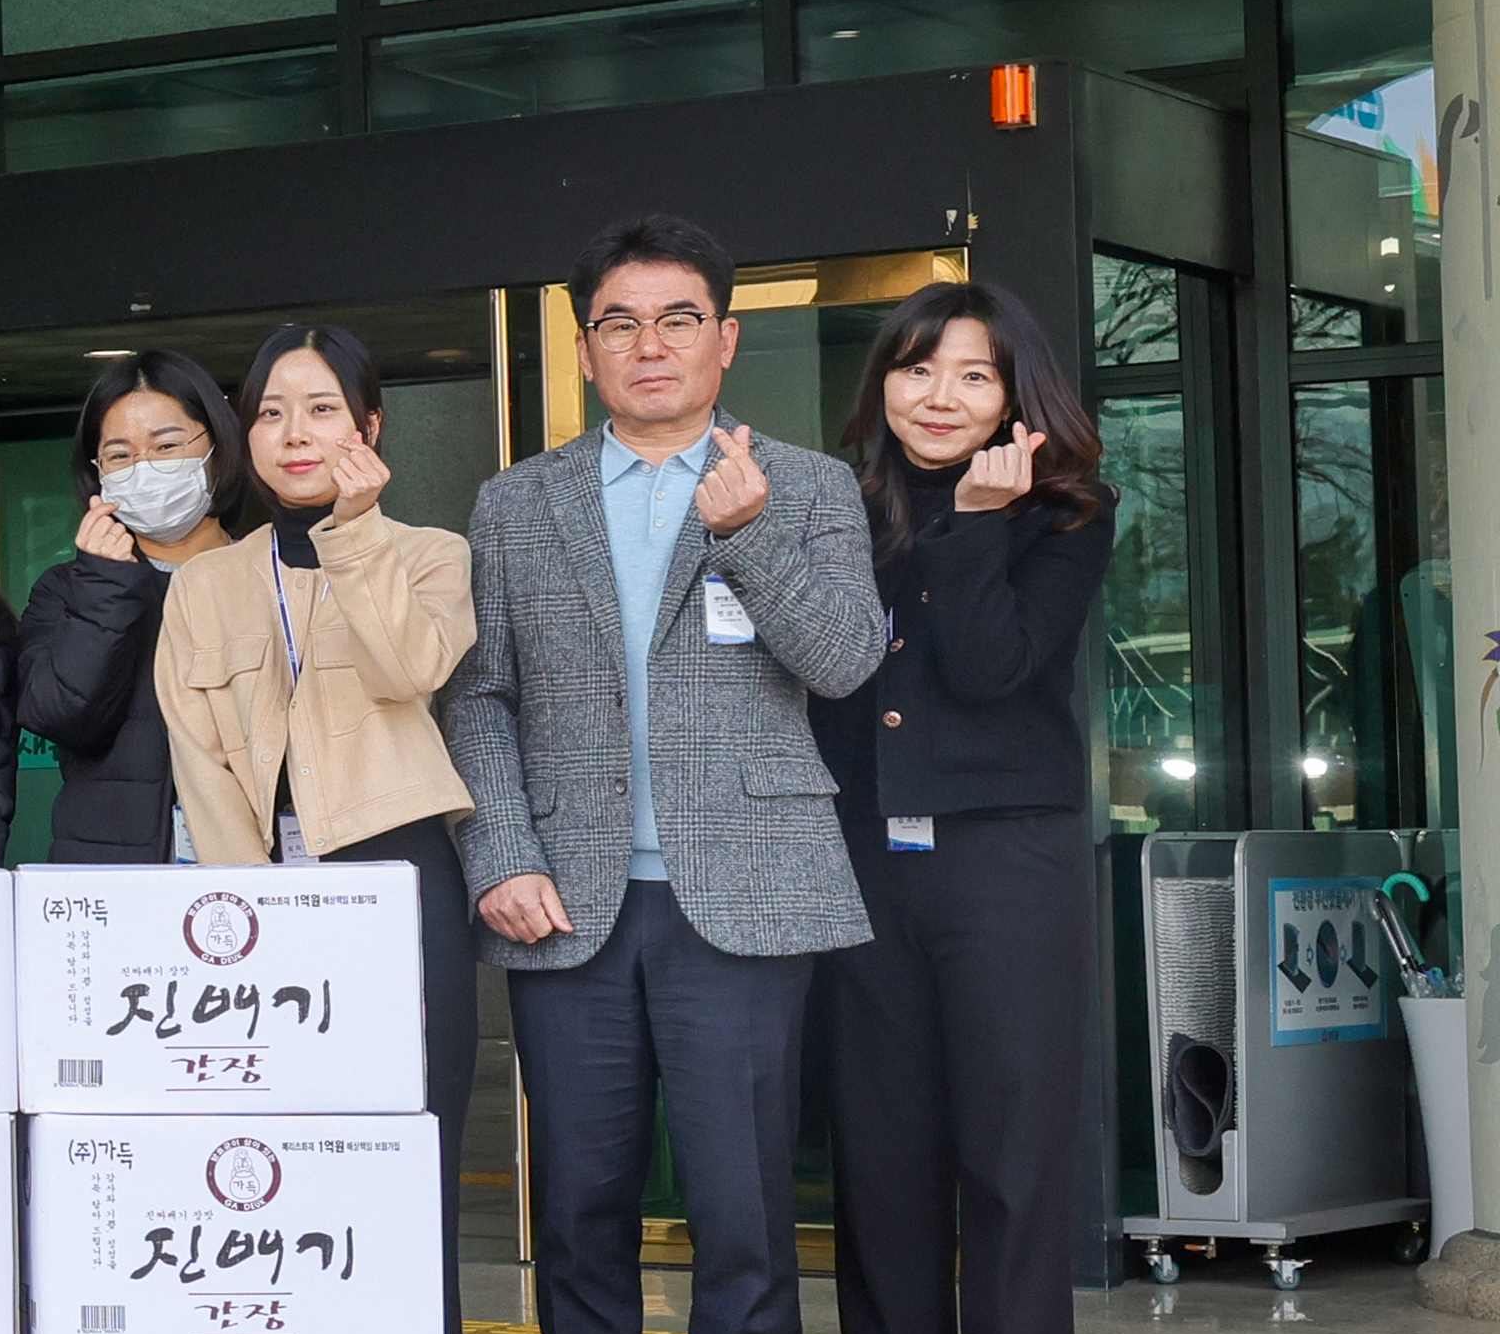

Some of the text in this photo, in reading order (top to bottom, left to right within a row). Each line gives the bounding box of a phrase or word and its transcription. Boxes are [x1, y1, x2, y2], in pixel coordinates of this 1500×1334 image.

[43, 897, 108, 927] (주)가득
[294, 894, 320, 907] 1억원
[210, 934, 233, 948] 가득
[201, 952, 244, 964] GA DEUK
[106, 980, 330, 1039] 진배기
[171, 1054, 264, 1084] 간장
[68, 1139, 133, 1170] (주)가득
[130, 1223, 352, 1286] 진배기
[195, 1299, 288, 1331] 간장
